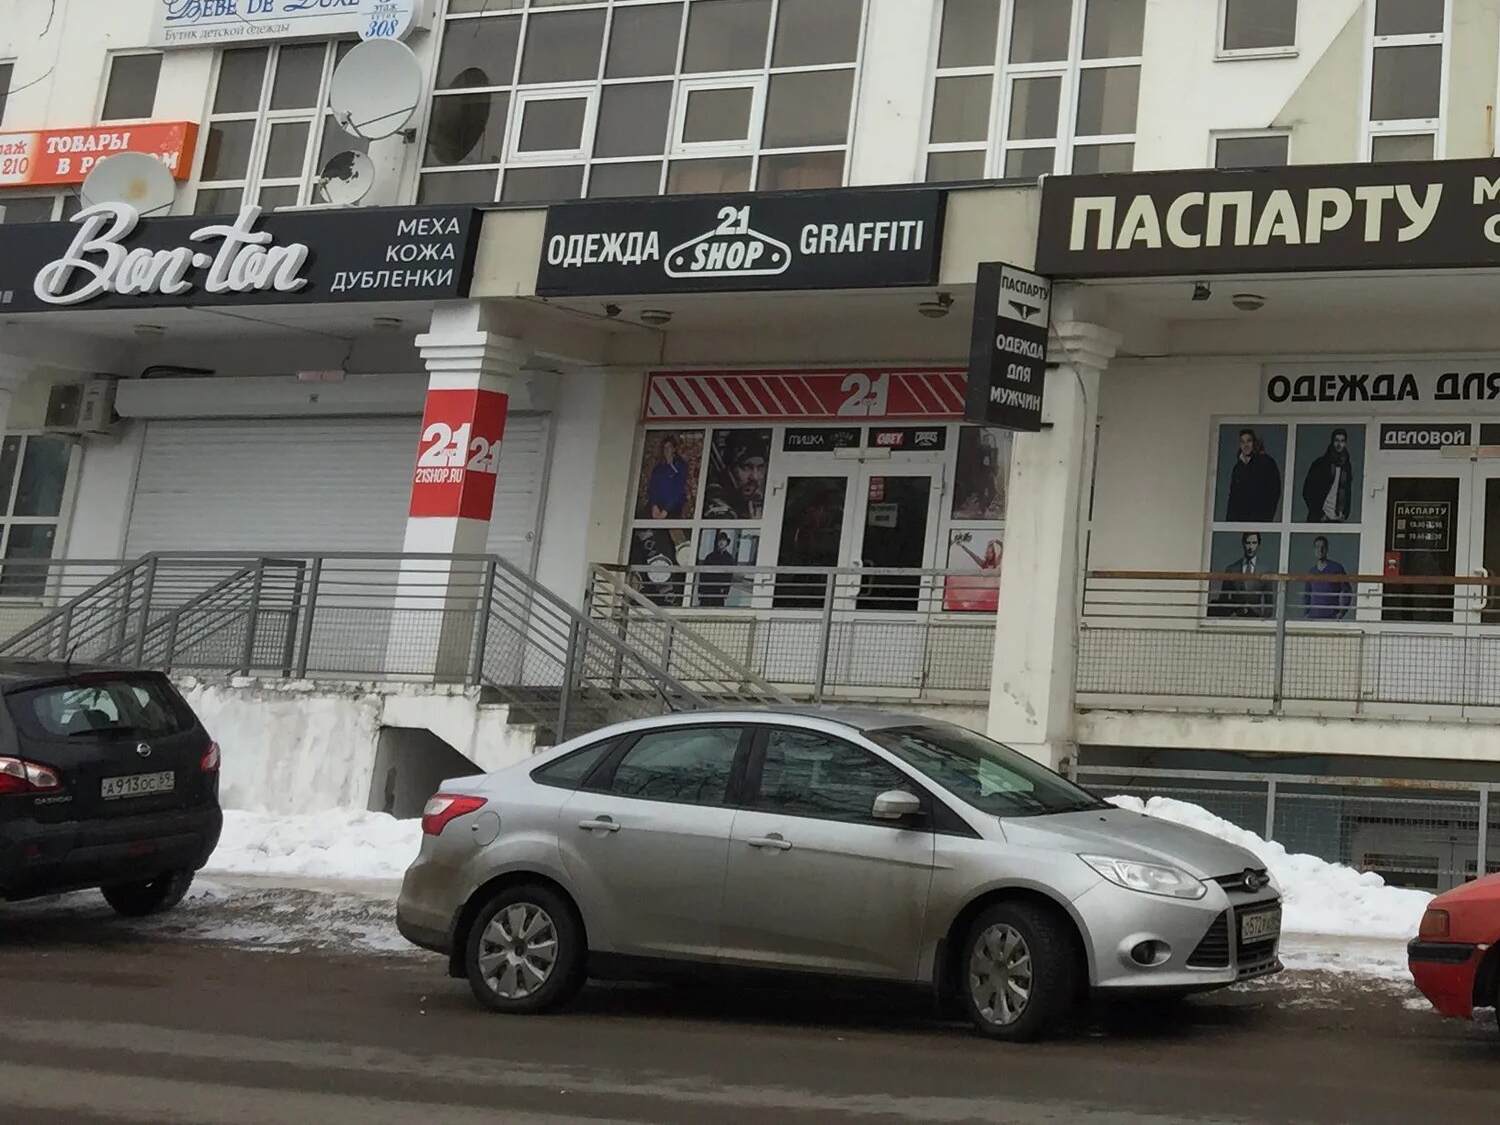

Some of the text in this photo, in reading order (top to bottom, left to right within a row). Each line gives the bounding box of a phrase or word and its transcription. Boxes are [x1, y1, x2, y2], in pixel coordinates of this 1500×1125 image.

[165, 23, 290, 41] Бутик детской одежды
[365, 18, 399, 37] 308
[0, 139, 27, 156] аж
[47, 132, 130, 154] ТОВАРЫ
[3, 157, 29, 175] 210
[56, 158, 72, 175] В
[396, 217, 461, 237] МЕХА
[716, 205, 751, 235] 21
[1068, 182, 1443, 251] ПАСПАРТУ
[548, 230, 660, 268] ОДЕЖДА
[800, 220, 924, 255] GRAFFITI
[385, 243, 456, 263] КОЖА
[691, 241, 764, 270] SHOP
[330, 268, 453, 293] ДУБЛЕНКИ
[1001, 276, 1050, 301] ПАСПАРТУ
[996, 333, 1045, 361] ОДЕЖДА
[1006, 363, 1032, 383] ДЛЯ
[837, 373, 890, 416] 21
[990, 386, 1041, 412] МУЖЧИН
[1267, 372, 1420, 403] ОДЕЖДА
[417, 422, 472, 467] 21
[876, 433, 904, 445] OBEY
[1384, 427, 1465, 447] ДЕЛОВОЙ
[466, 436, 502, 474] 21
[415, 468, 463, 483] 21SHOP.RU
[1397, 507, 1447, 515] ПАСПАРТУ
